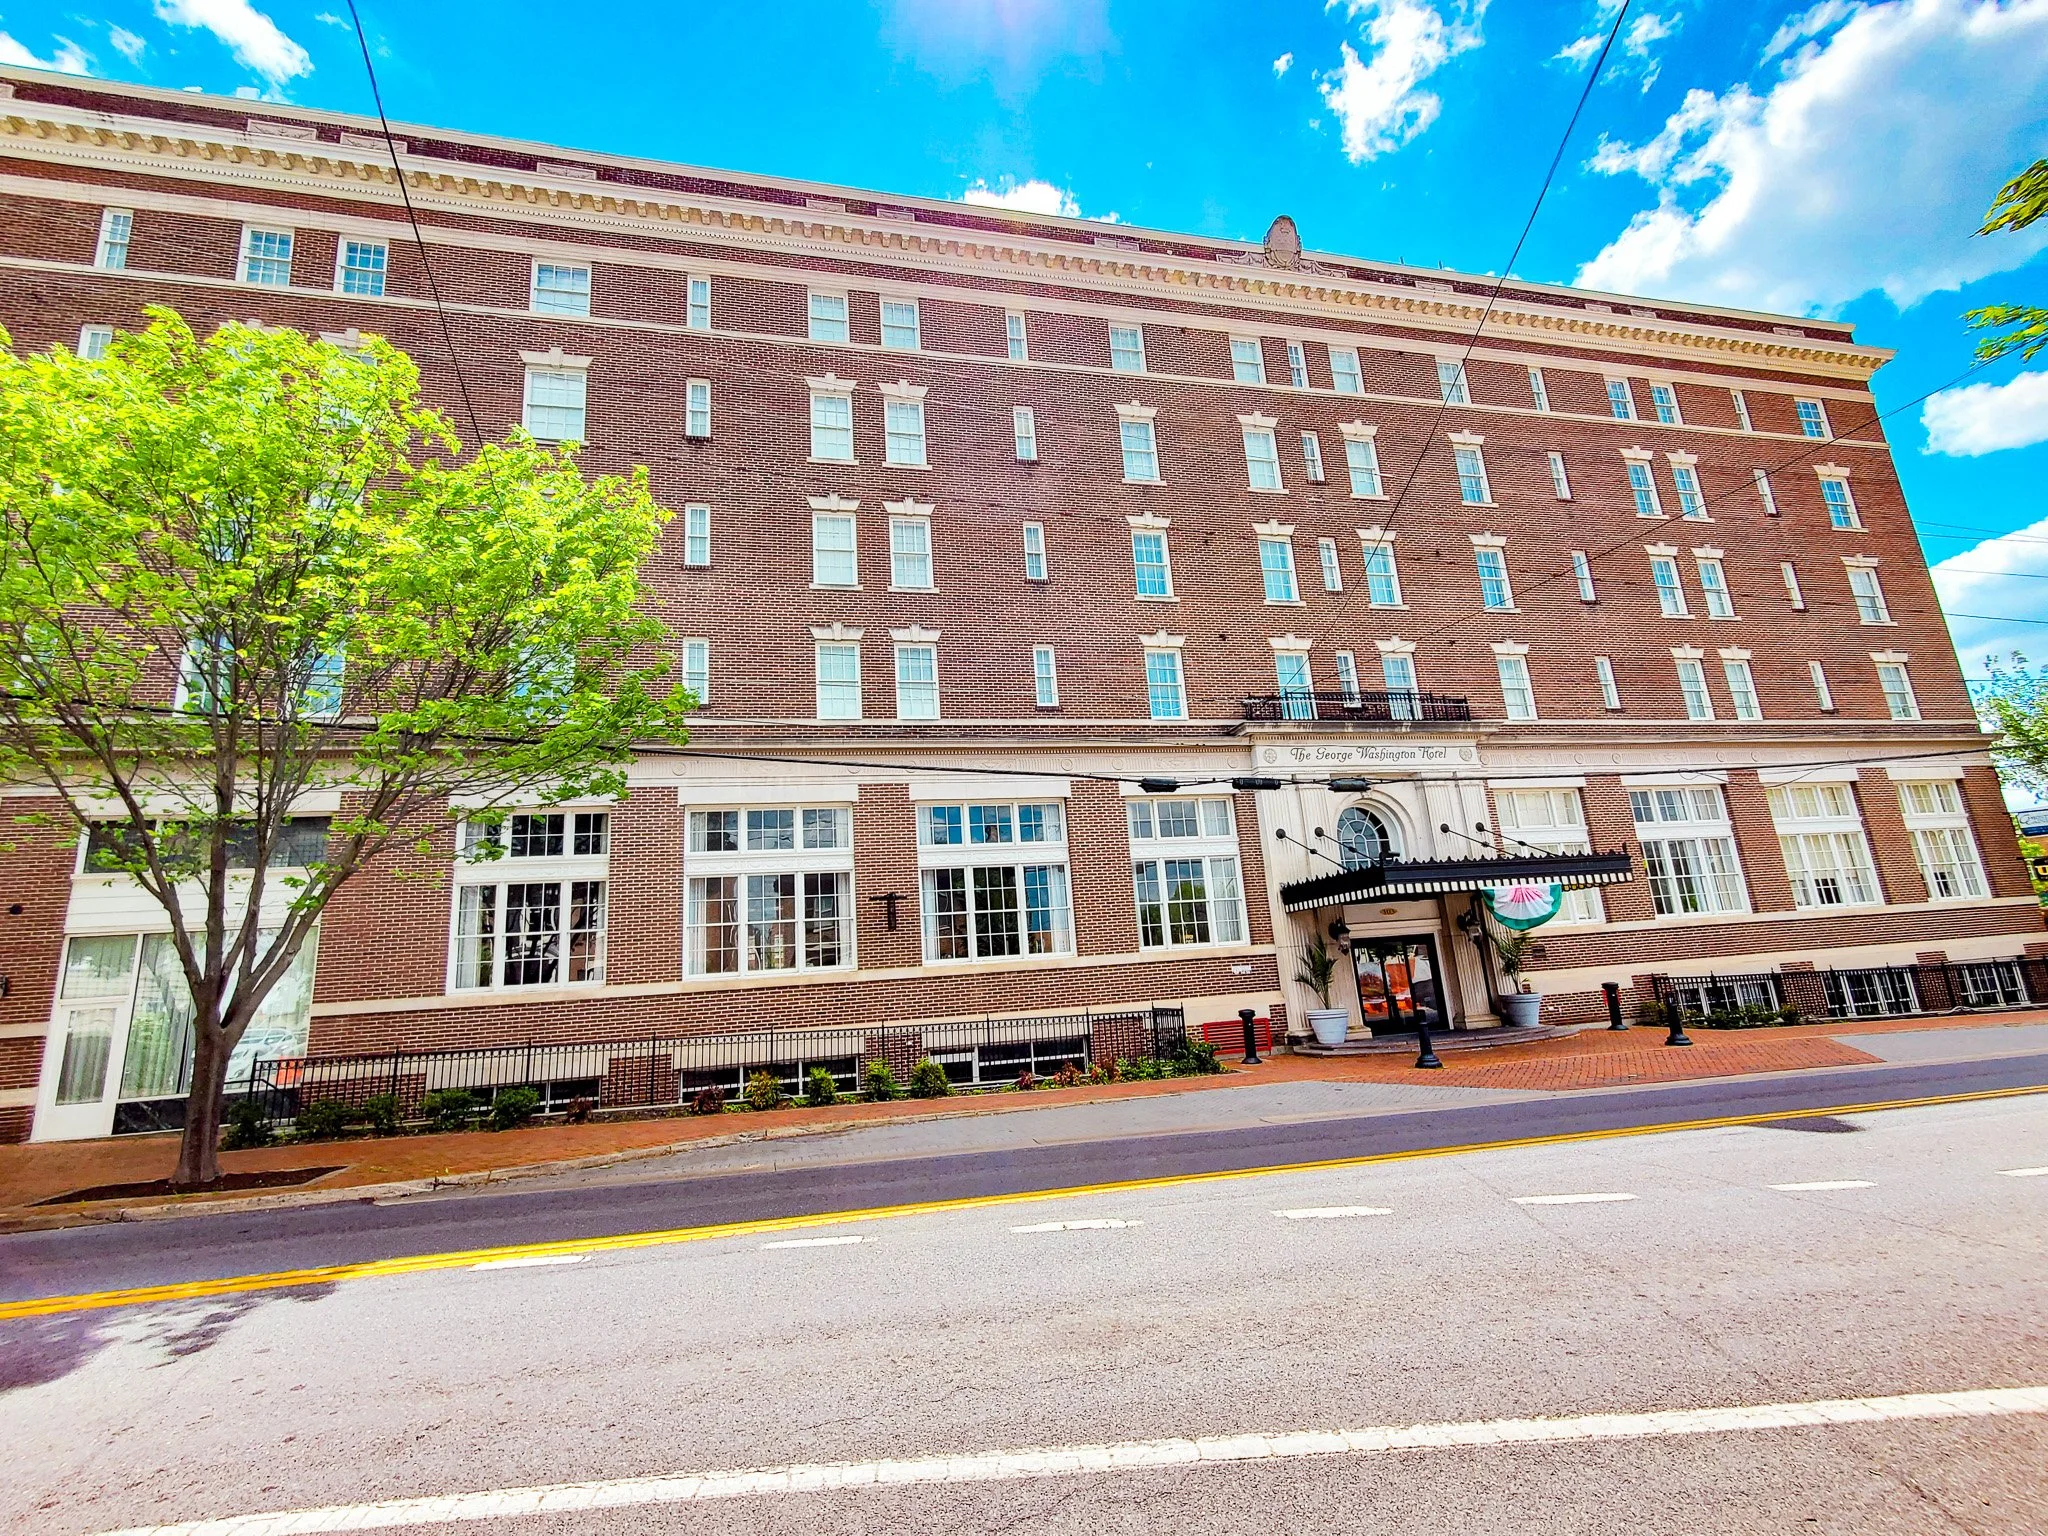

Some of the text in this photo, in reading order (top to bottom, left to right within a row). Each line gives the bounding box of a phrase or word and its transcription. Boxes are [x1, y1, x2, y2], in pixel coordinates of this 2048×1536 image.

[1290, 746, 1447, 763] The George Washington Hotel
